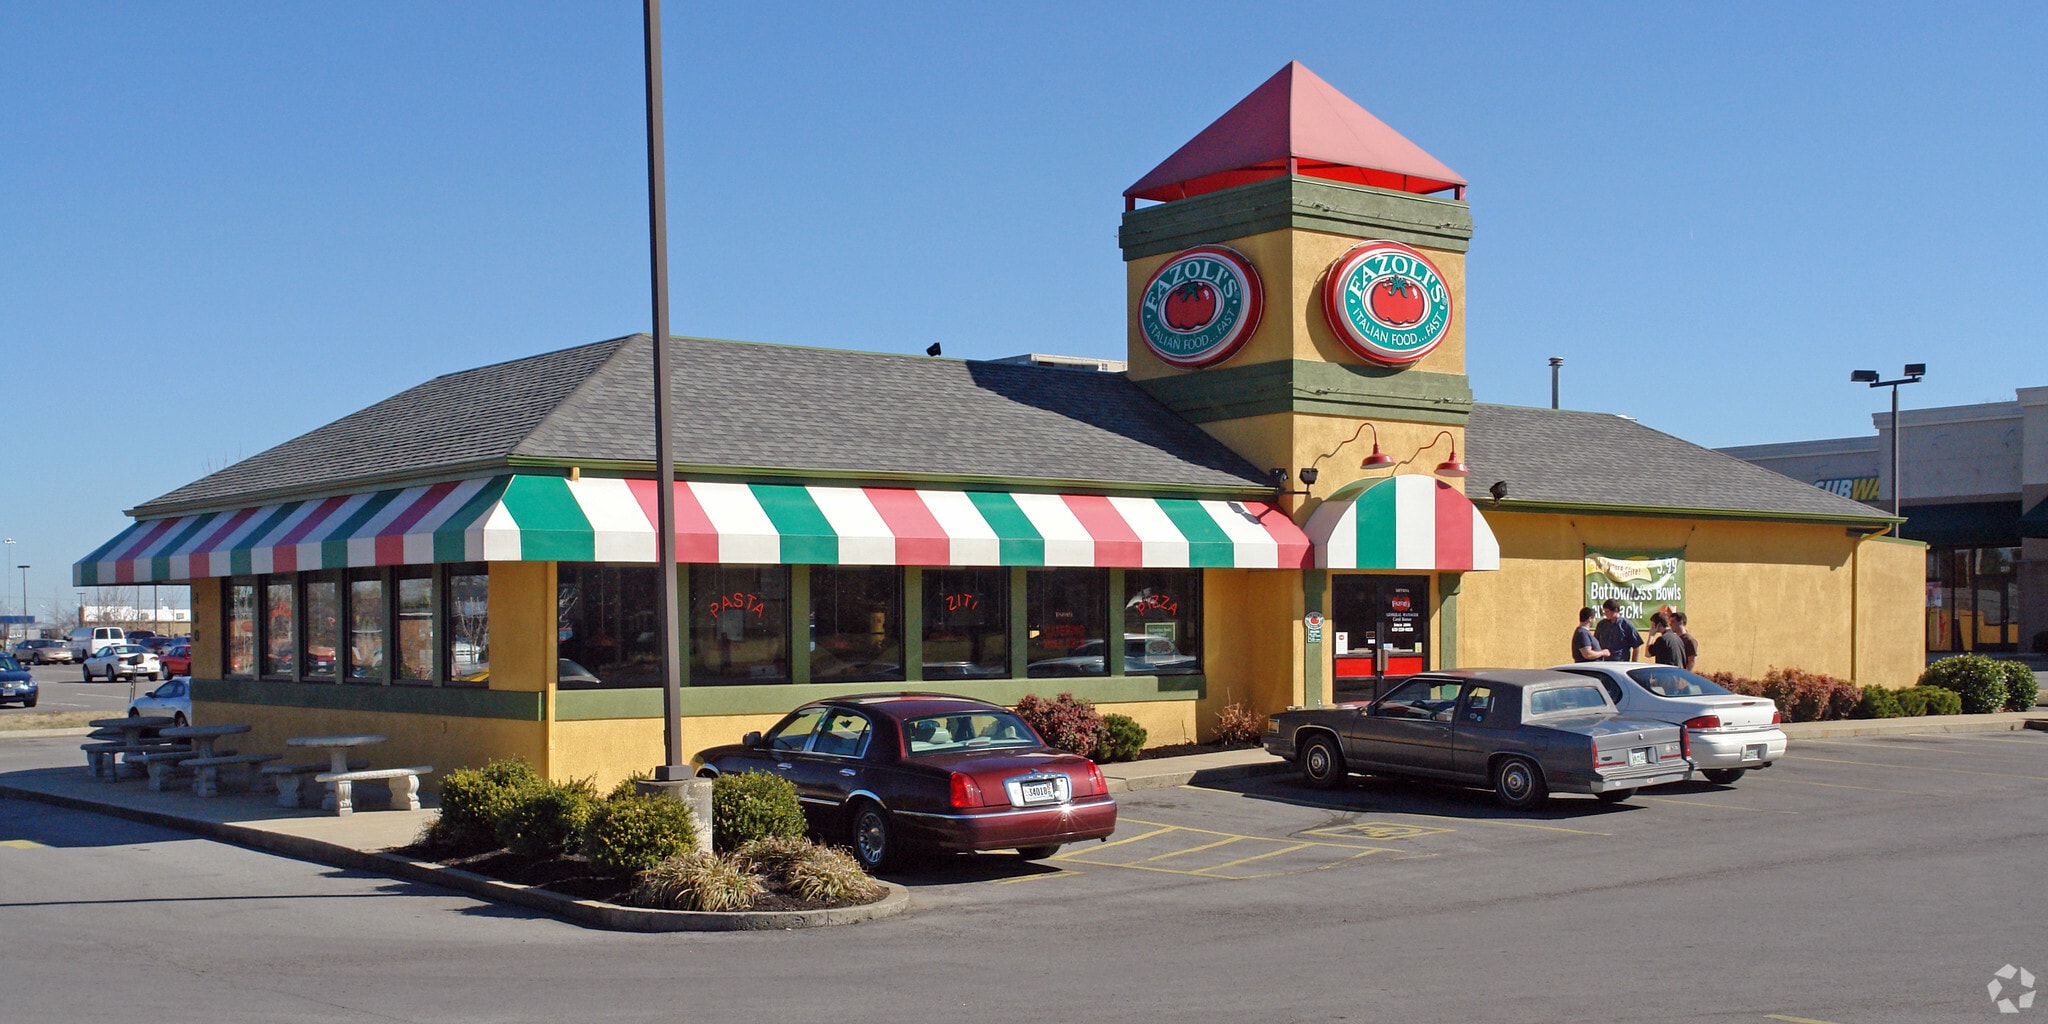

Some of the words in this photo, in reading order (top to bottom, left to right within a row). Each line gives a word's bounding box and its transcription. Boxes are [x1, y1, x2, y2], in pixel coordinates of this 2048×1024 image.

[1145, 261, 1238, 312] FAZOLI'S
[1349, 255, 1444, 303] FAZOLI'S
[1149, 321, 1180, 350] ITALIAN
[1353, 308, 1389, 343] ITALIAN
[1814, 478, 1880, 500] UBWA
[945, 594, 978, 611] ZITI
[1656, 583, 1681, 600] Bowls
[710, 592, 764, 619] PASTA
[1137, 594, 1178, 616] PIZZA
[1619, 601, 1643, 619] ack!
